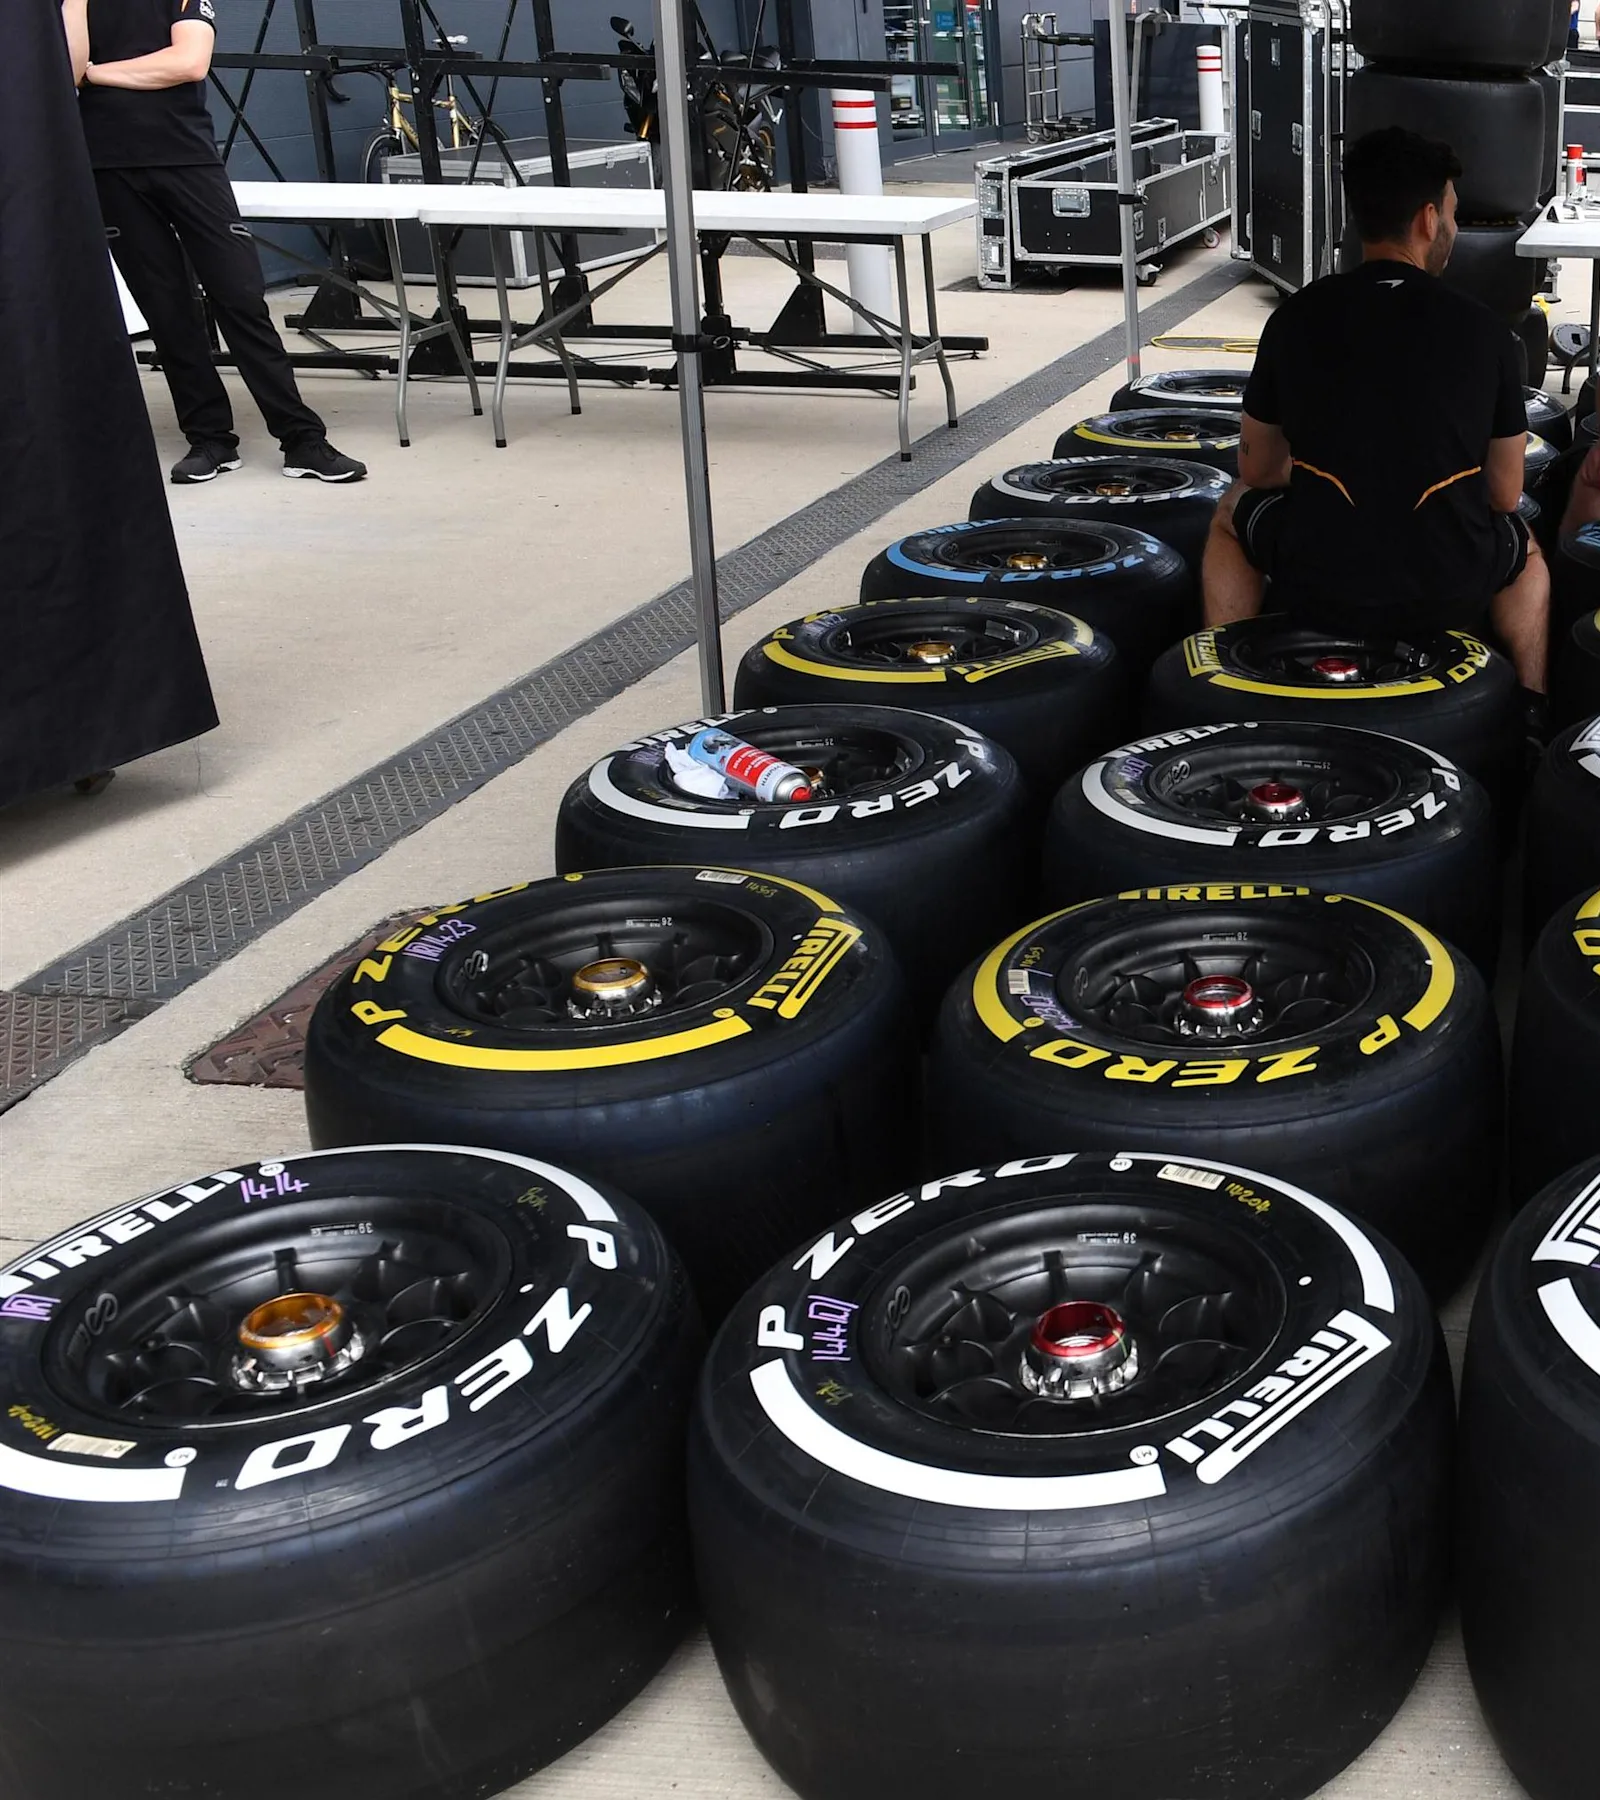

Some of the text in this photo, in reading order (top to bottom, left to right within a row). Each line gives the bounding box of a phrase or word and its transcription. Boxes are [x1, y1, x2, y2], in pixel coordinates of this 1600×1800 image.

[1000, 541, 1160, 583] P ZERO
[772, 628, 795, 640] P
[1183, 629, 1223, 678] PIRELLI
[1446, 630, 1491, 683] ZERO
[622, 708, 757, 752] PIRELLI
[1104, 722, 1239, 759] PIRELLI
[778, 738, 986, 830] P ZERO
[1257, 767, 1461, 848] P ZERO
[1118, 884, 1310, 901] PIRELLI
[661, 916, 672, 926] 26
[747, 916, 864, 1020] PIRELLI
[351, 1000, 407, 1027] P
[1029, 1014, 1401, 1087] P ZERO
[1113, 1159, 1131, 1169] M1
[240, 1172, 310, 1203] 1414
[1225, 1182, 1271, 1214] 14204
[358, 1222, 374, 1235] 39
[1122, 1232, 1137, 1245] 39
[757, 1152, 1080, 1350] P ZERO
[235, 1223, 618, 1491] P ZERO
[1164, 1309, 1393, 1486] PIRELLI
[1135, 1449, 1154, 1462] M1
